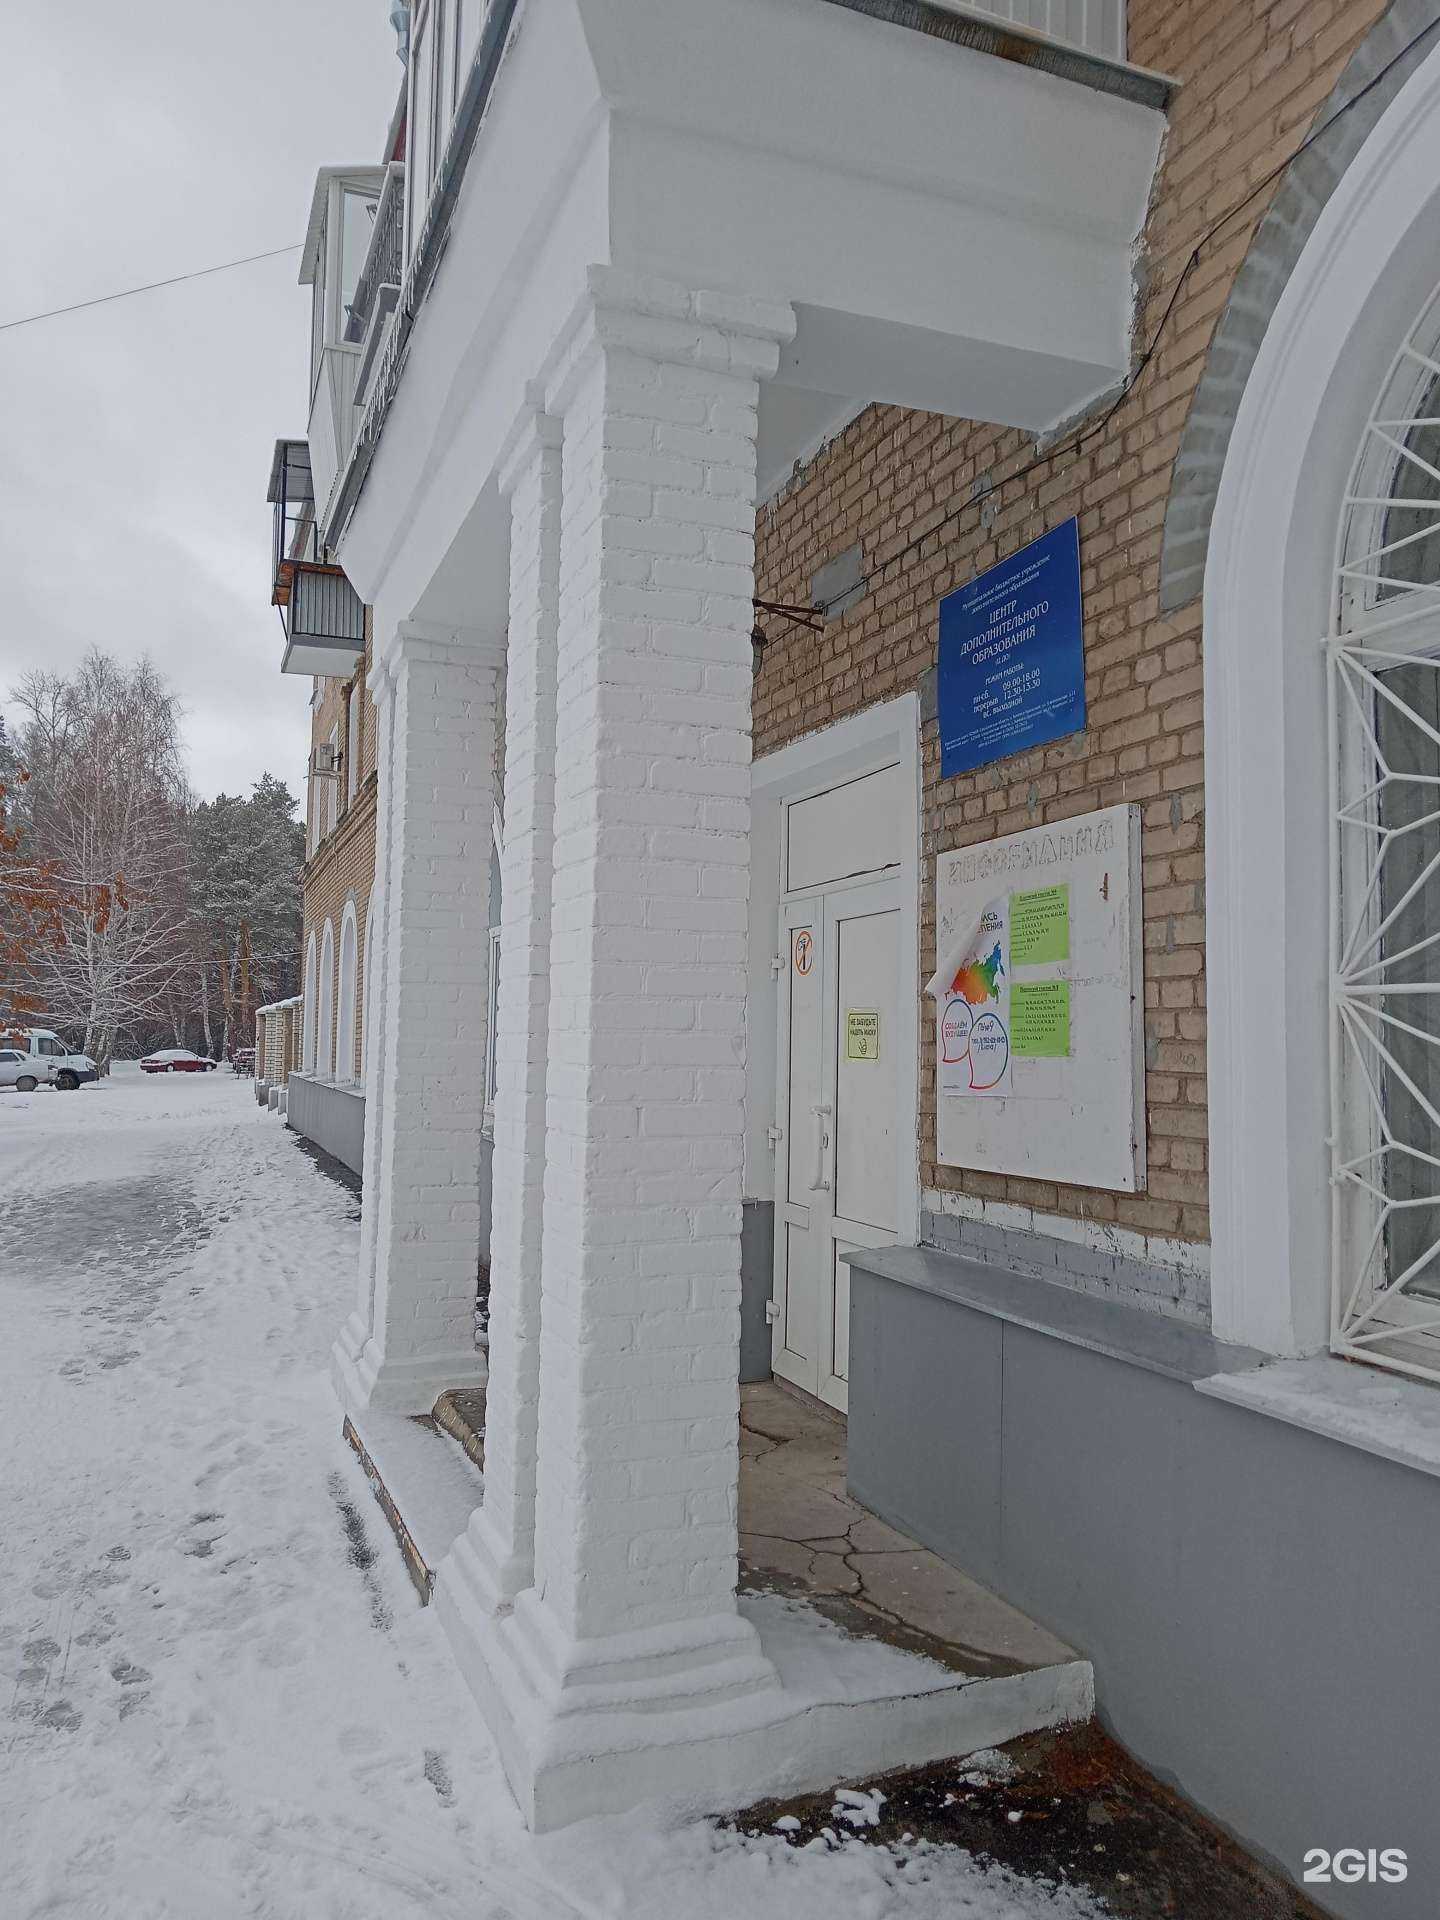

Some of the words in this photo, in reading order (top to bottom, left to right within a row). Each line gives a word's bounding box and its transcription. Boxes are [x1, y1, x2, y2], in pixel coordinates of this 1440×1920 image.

[960, 600, 1049, 656] ДОПОЛНИТЕЛЬНОГО
[989, 599, 1017, 624] ЦЕНТР
[972, 624, 1036, 665] ОБРАЗОВАНИЯ
